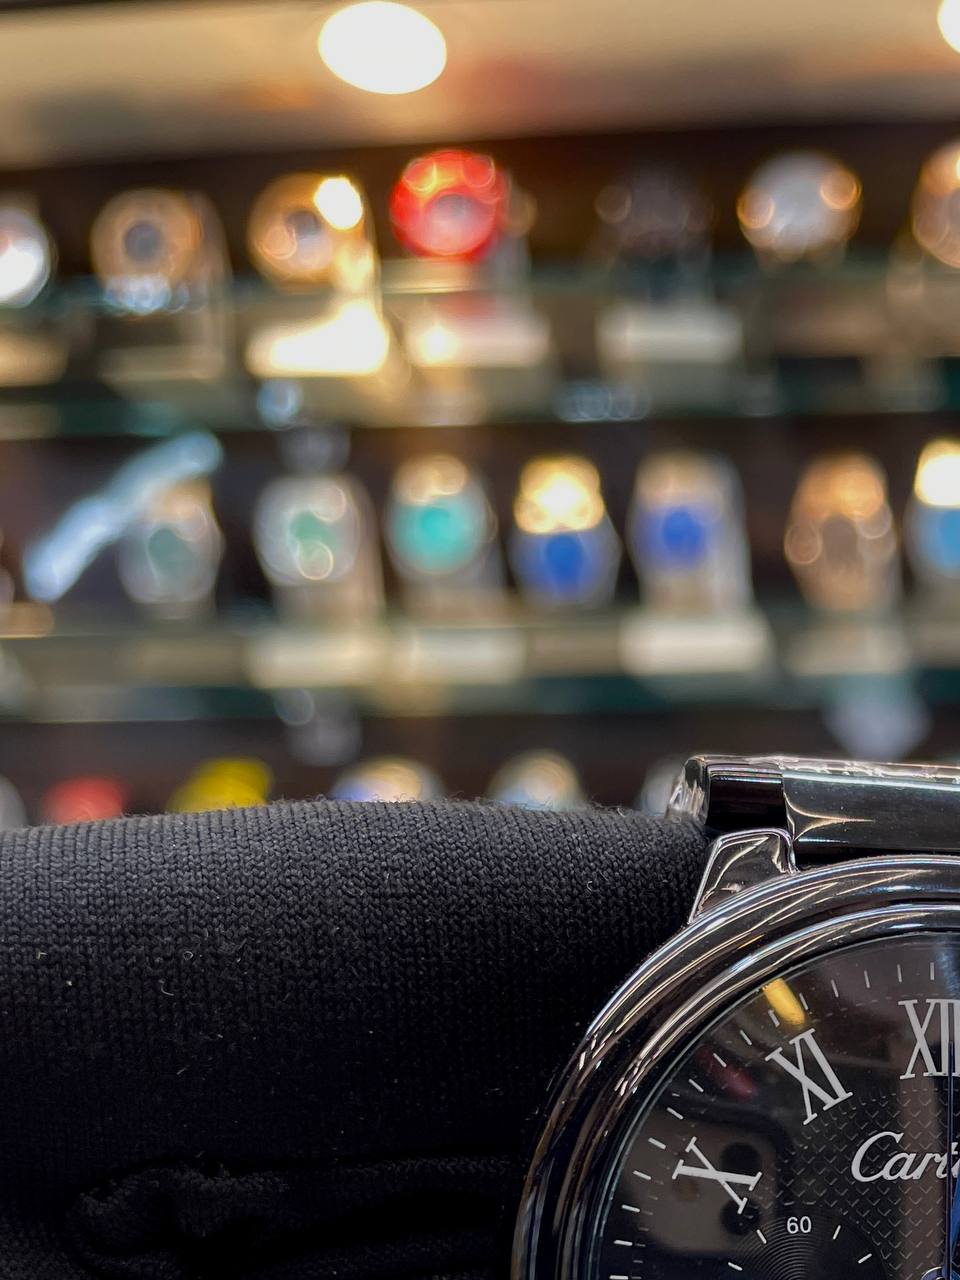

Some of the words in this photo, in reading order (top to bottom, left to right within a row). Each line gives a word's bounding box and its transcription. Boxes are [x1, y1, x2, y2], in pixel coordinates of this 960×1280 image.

[765, 1028, 853, 1125] XI
[671, 1136, 763, 1214] X
[786, 1216, 812, 1234] 60
